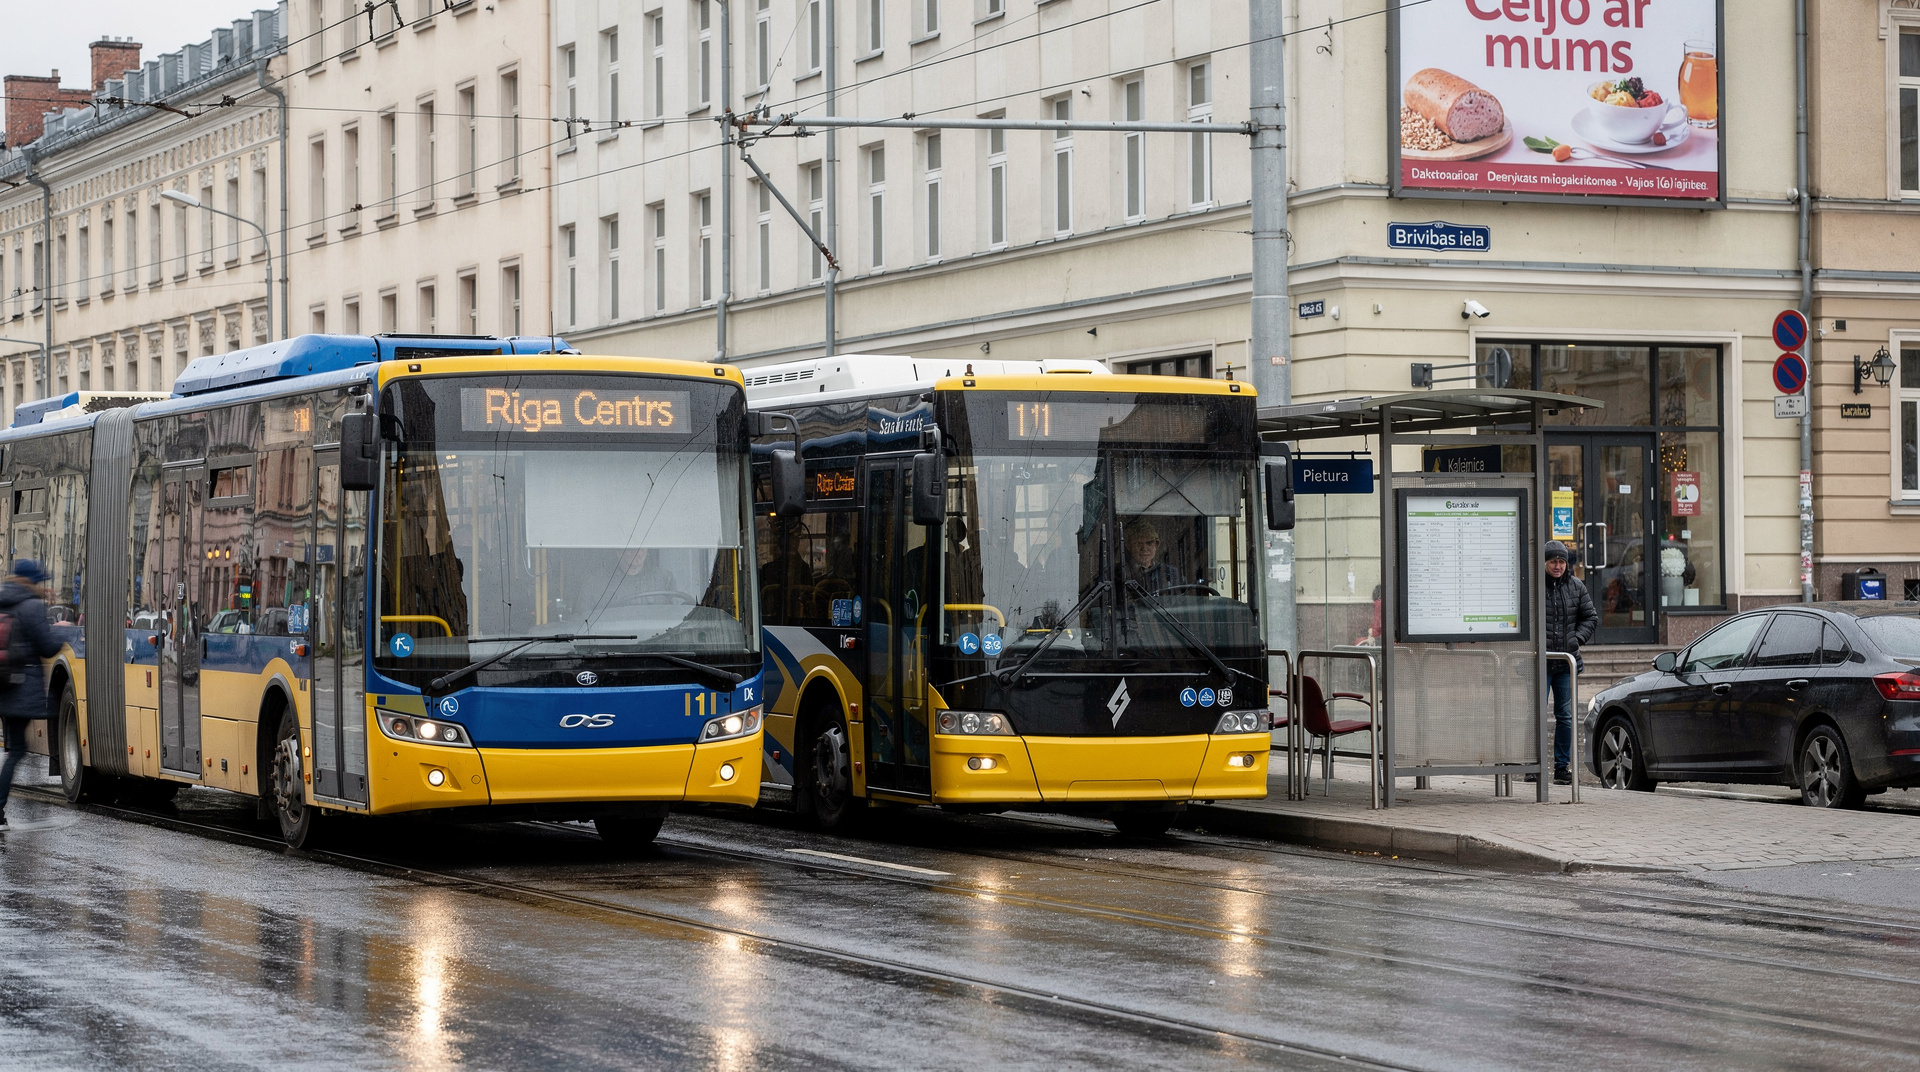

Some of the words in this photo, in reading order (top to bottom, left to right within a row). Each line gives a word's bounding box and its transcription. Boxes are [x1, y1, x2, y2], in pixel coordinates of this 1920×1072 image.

[1603, 0, 1652, 29] ar
[1485, 34, 1634, 74] mums
[1395, 228, 1456, 246] Brivibas
[1459, 230, 1484, 247] iela
[485, 388, 563, 432] Riga
[574, 390, 674, 427] Centrs
[1016, 403, 1049, 437] 111
[1303, 469, 1349, 482] Pietura
